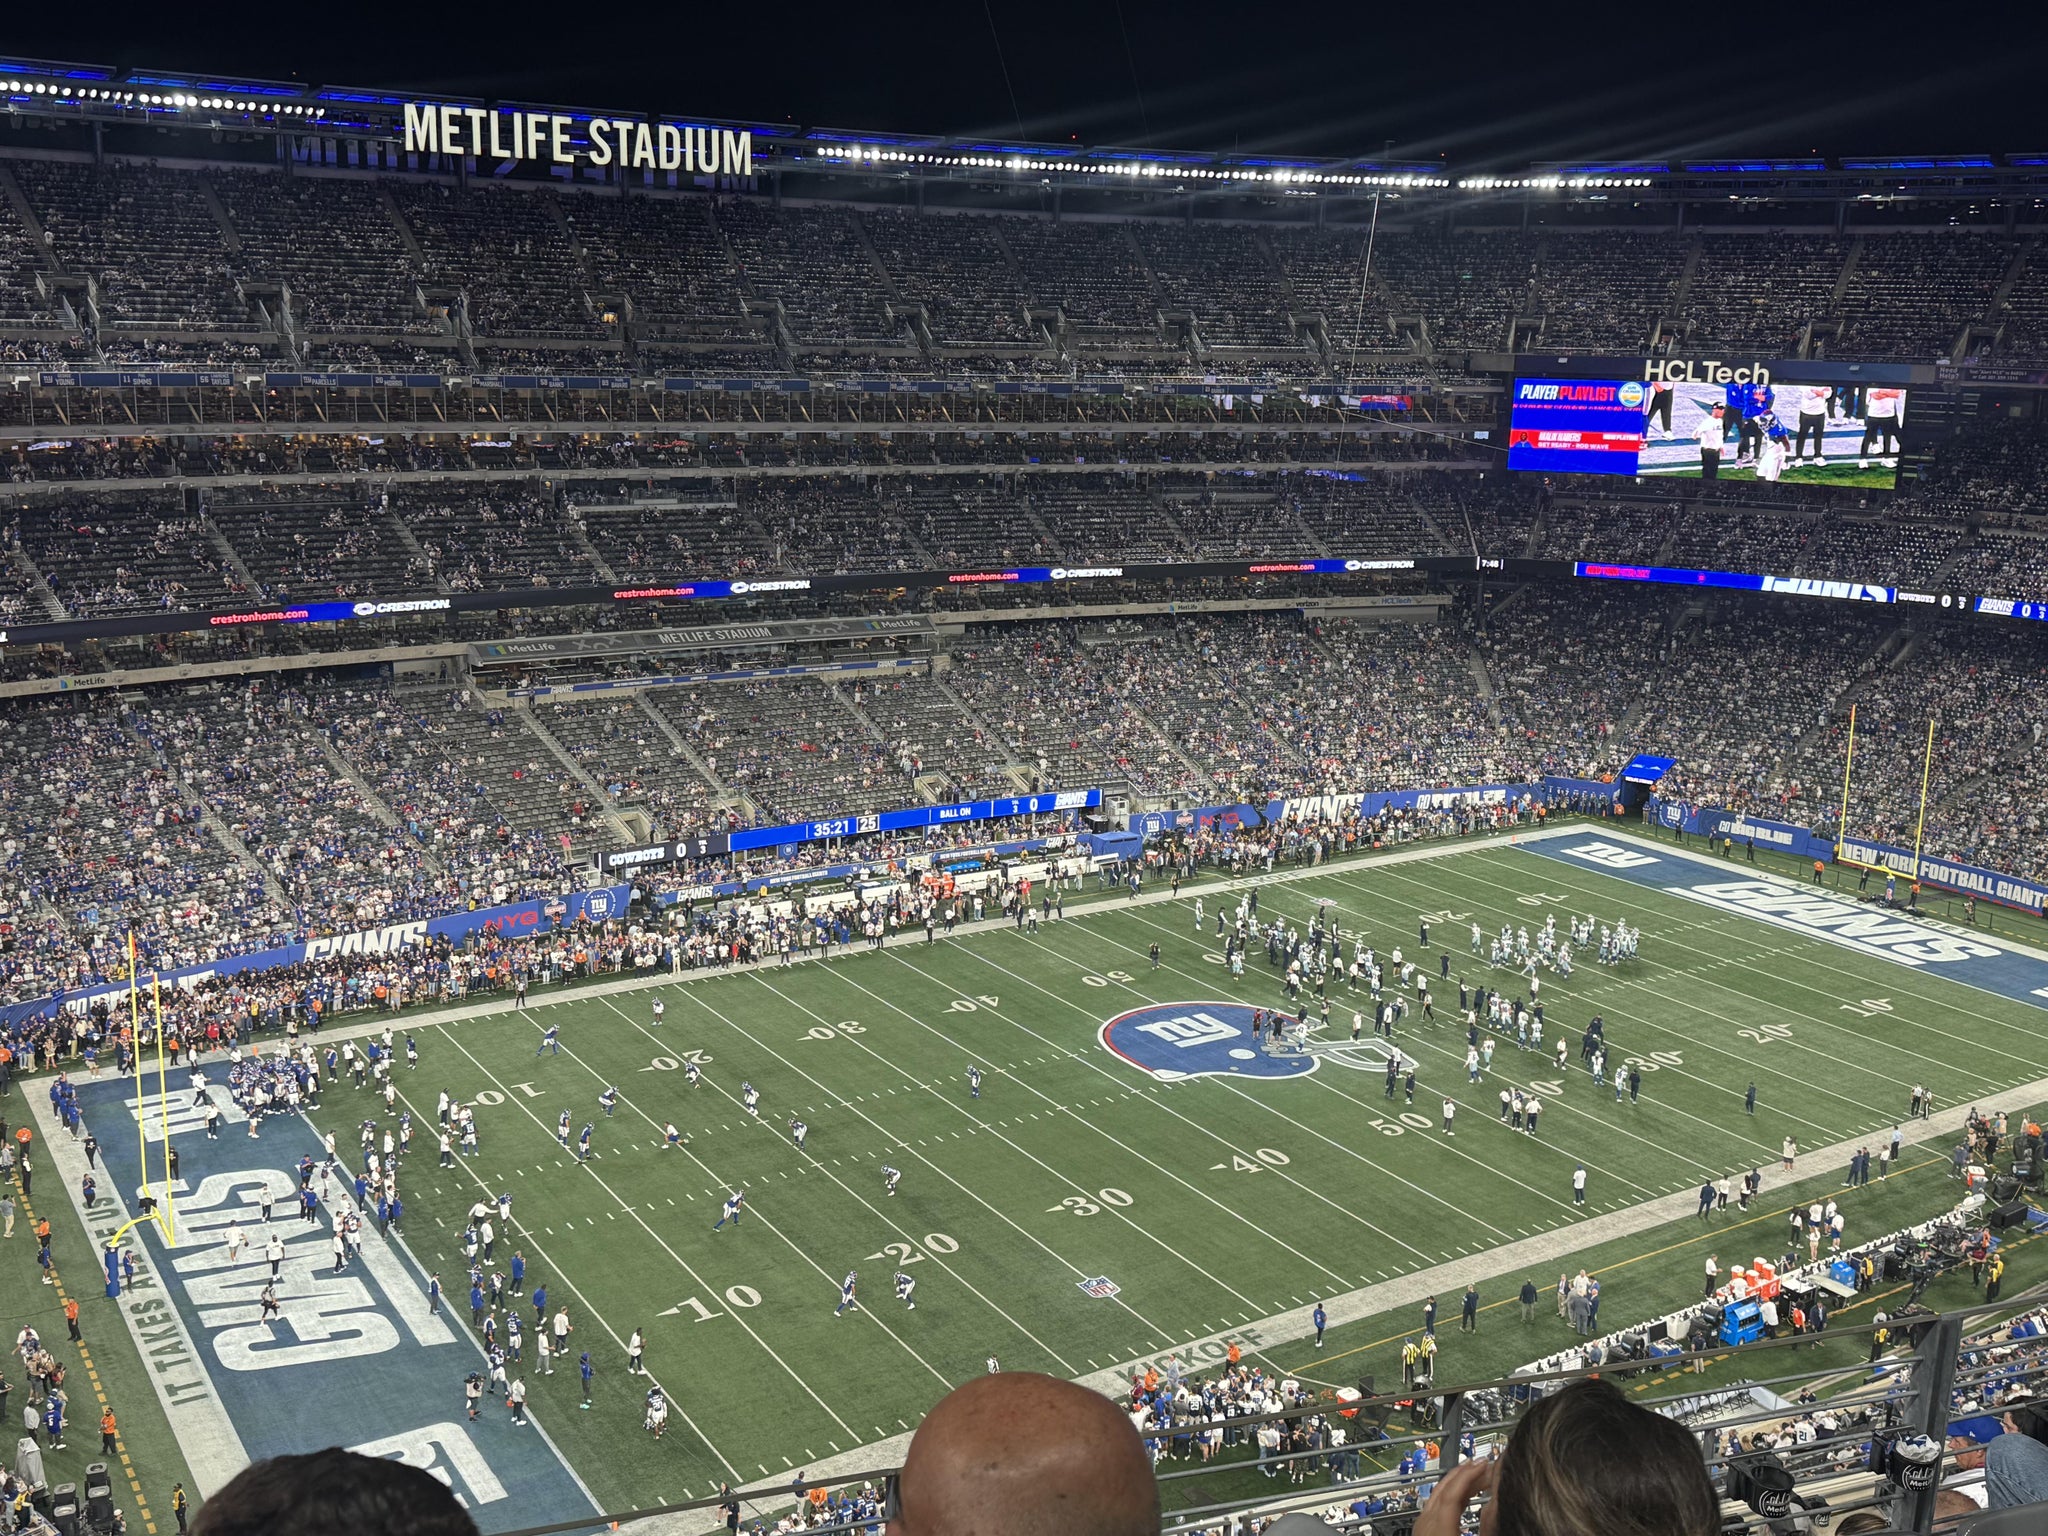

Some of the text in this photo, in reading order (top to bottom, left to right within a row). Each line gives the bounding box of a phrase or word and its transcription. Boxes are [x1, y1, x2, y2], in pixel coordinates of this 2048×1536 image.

[403, 102, 575, 164] METLIFE
[588, 118, 753, 177] STADIUM
[1644, 359, 1770, 385] HCLTech
[1520, 384, 1559, 400] PLAYER
[1560, 386, 1616, 402] PLAYLIST
[949, 572, 1019, 582] crestronhome.com
[1249, 563, 1315, 573] crestronhome.com
[614, 587, 695, 599] crestronhome.com
[1898, 592, 1936, 603] COWBOYS
[1941, 594, 1952, 608] 0
[1177, 603, 1198, 611] MetLife
[1295, 599, 1319, 607] verizon
[1979, 598, 2015, 612] GIANTS
[2021, 604, 2032, 617] 0
[210, 610, 309, 625] crestronhome.com
[880, 619, 920, 628] MetLife
[657, 627, 772, 645] METLIFE STADIUM
[507, 642, 556, 653] MetLife
[73, 677, 106, 687] MetLife
[550, 685, 574, 694] GIANTS
[1012, 805, 1018, 814] 3
[1029, 798, 1038, 811] 0
[1054, 792, 1088, 809] GIANTS
[940, 807, 971, 819] BALL ON
[1200, 813, 1239, 826] NG
[813, 820, 849, 837] 35:21
[859, 817, 877, 831] 25
[1718, 820, 1793, 845] GO BIG BLUE
[608, 847, 665, 866] COWBOYS
[676, 842, 687, 858] 0
[700, 846, 707, 854] 3
[1842, 842, 1877, 864] NEW
[1920, 860, 1994, 895] FOOTBALL
[676, 886, 714, 903] GIANTS
[1517, 893, 1564, 906] 10
[590, 898, 608, 914] ny
[1418, 909, 1466, 924] 20
[1690, 881, 2002, 963] GIANTS
[1891, 909, 1976, 936] ORGET
[303, 920, 428, 965] GIANTS
[1081, 969, 1136, 988] 50
[951, 994, 1002, 1013] 40
[1839, 998, 1894, 1018] 10
[805, 1020, 867, 1042] 30
[1134, 1012, 1242, 1048] ny
[1737, 1023, 1793, 1045] 20
[649, 1049, 714, 1072] 20
[1624, 1051, 1684, 1072] 30
[475, 1081, 546, 1106] 10
[1367, 1112, 1435, 1137] 50
[1228, 1149, 1292, 1175] 40
[85, 1196, 121, 1223] US
[1060, 1187, 1134, 1218] 30
[883, 1233, 960, 1267] 20
[136, 1164, 402, 1371] GIANTS
[1088, 1282, 1117, 1297] NFL
[676, 1284, 762, 1323] 10
[130, 1297, 192, 1373] TAKES
[1115, 1327, 1266, 1385] KICKOFF
[164, 1380, 209, 1407] IT
